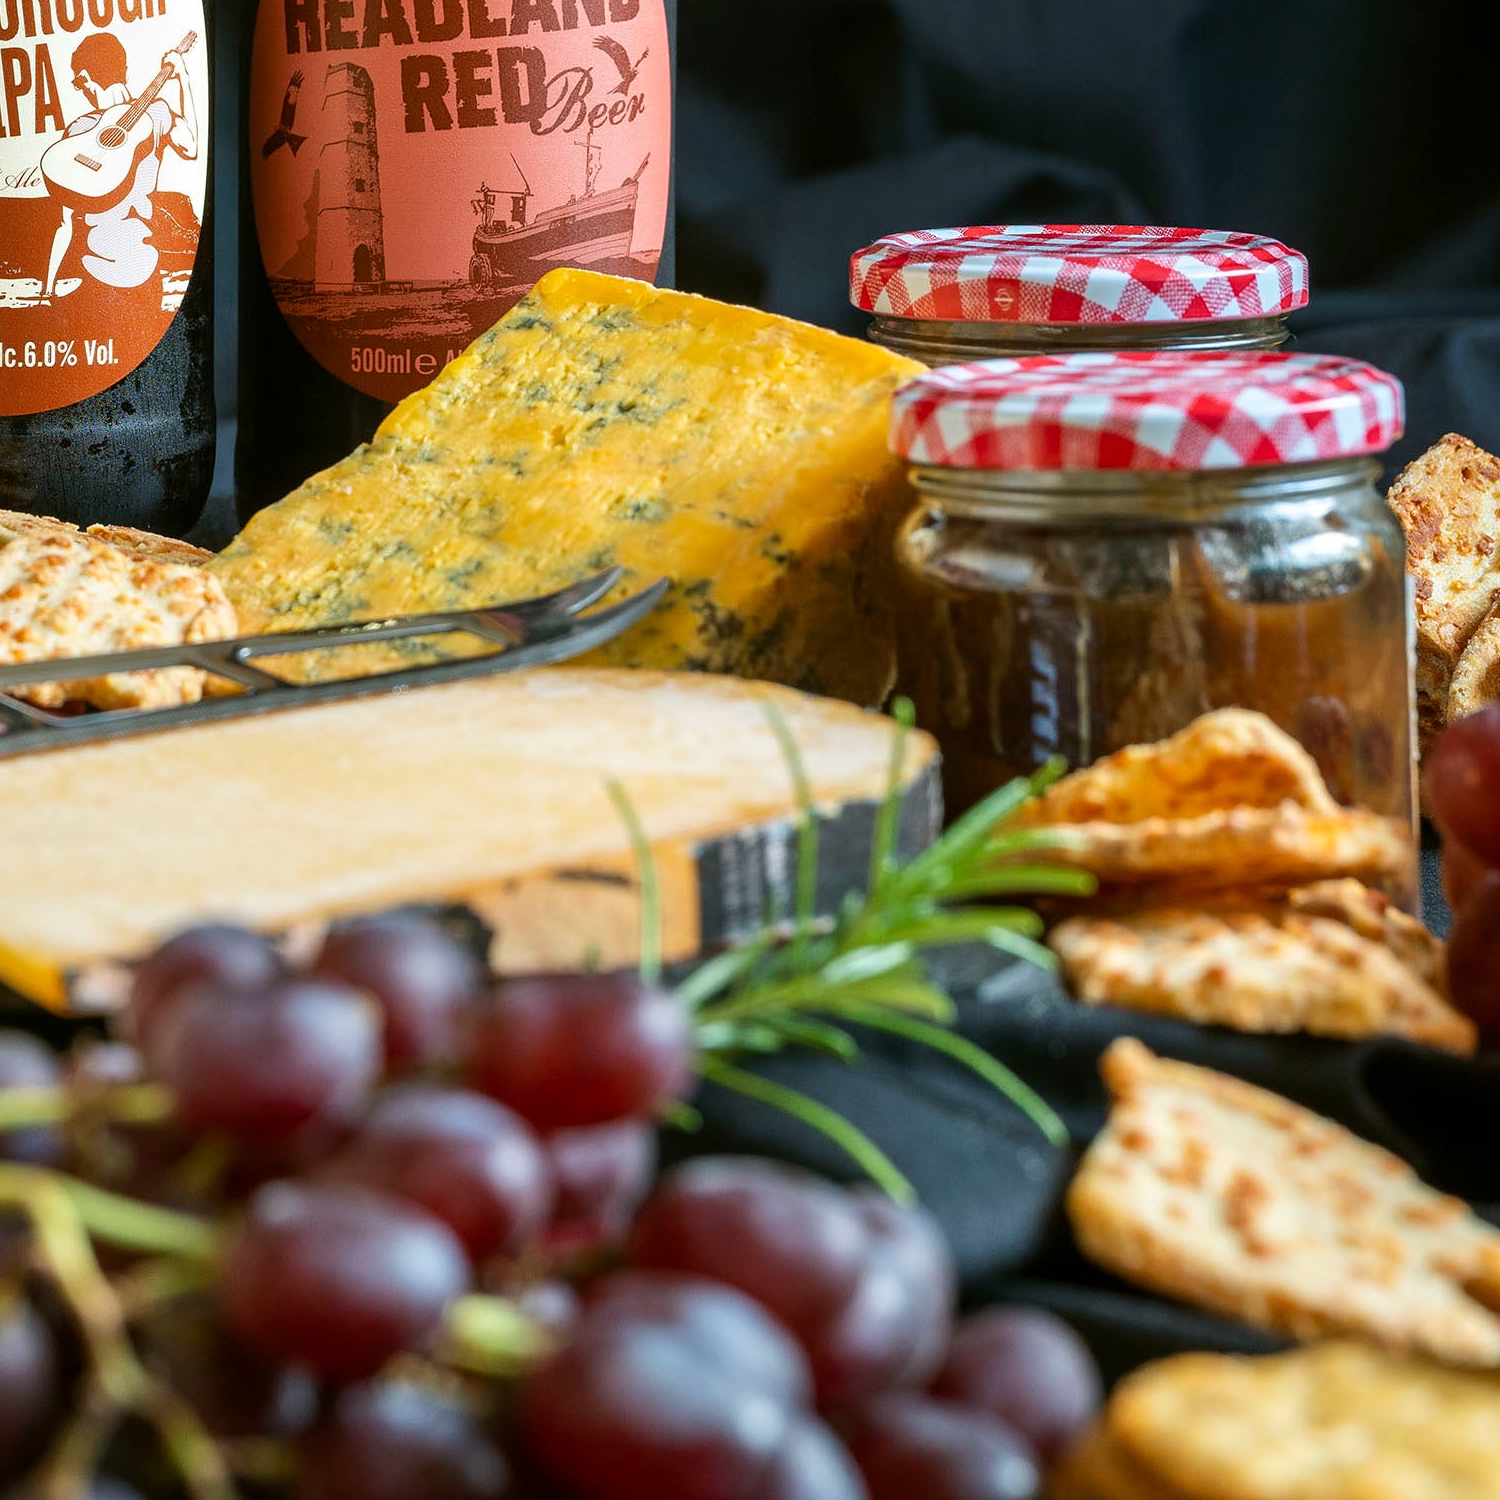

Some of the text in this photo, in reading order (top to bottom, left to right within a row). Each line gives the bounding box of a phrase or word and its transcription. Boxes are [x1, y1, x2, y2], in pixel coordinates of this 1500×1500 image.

[400, 45, 645, 136] RED Beer
[84, 338, 119, 366] Vol.
